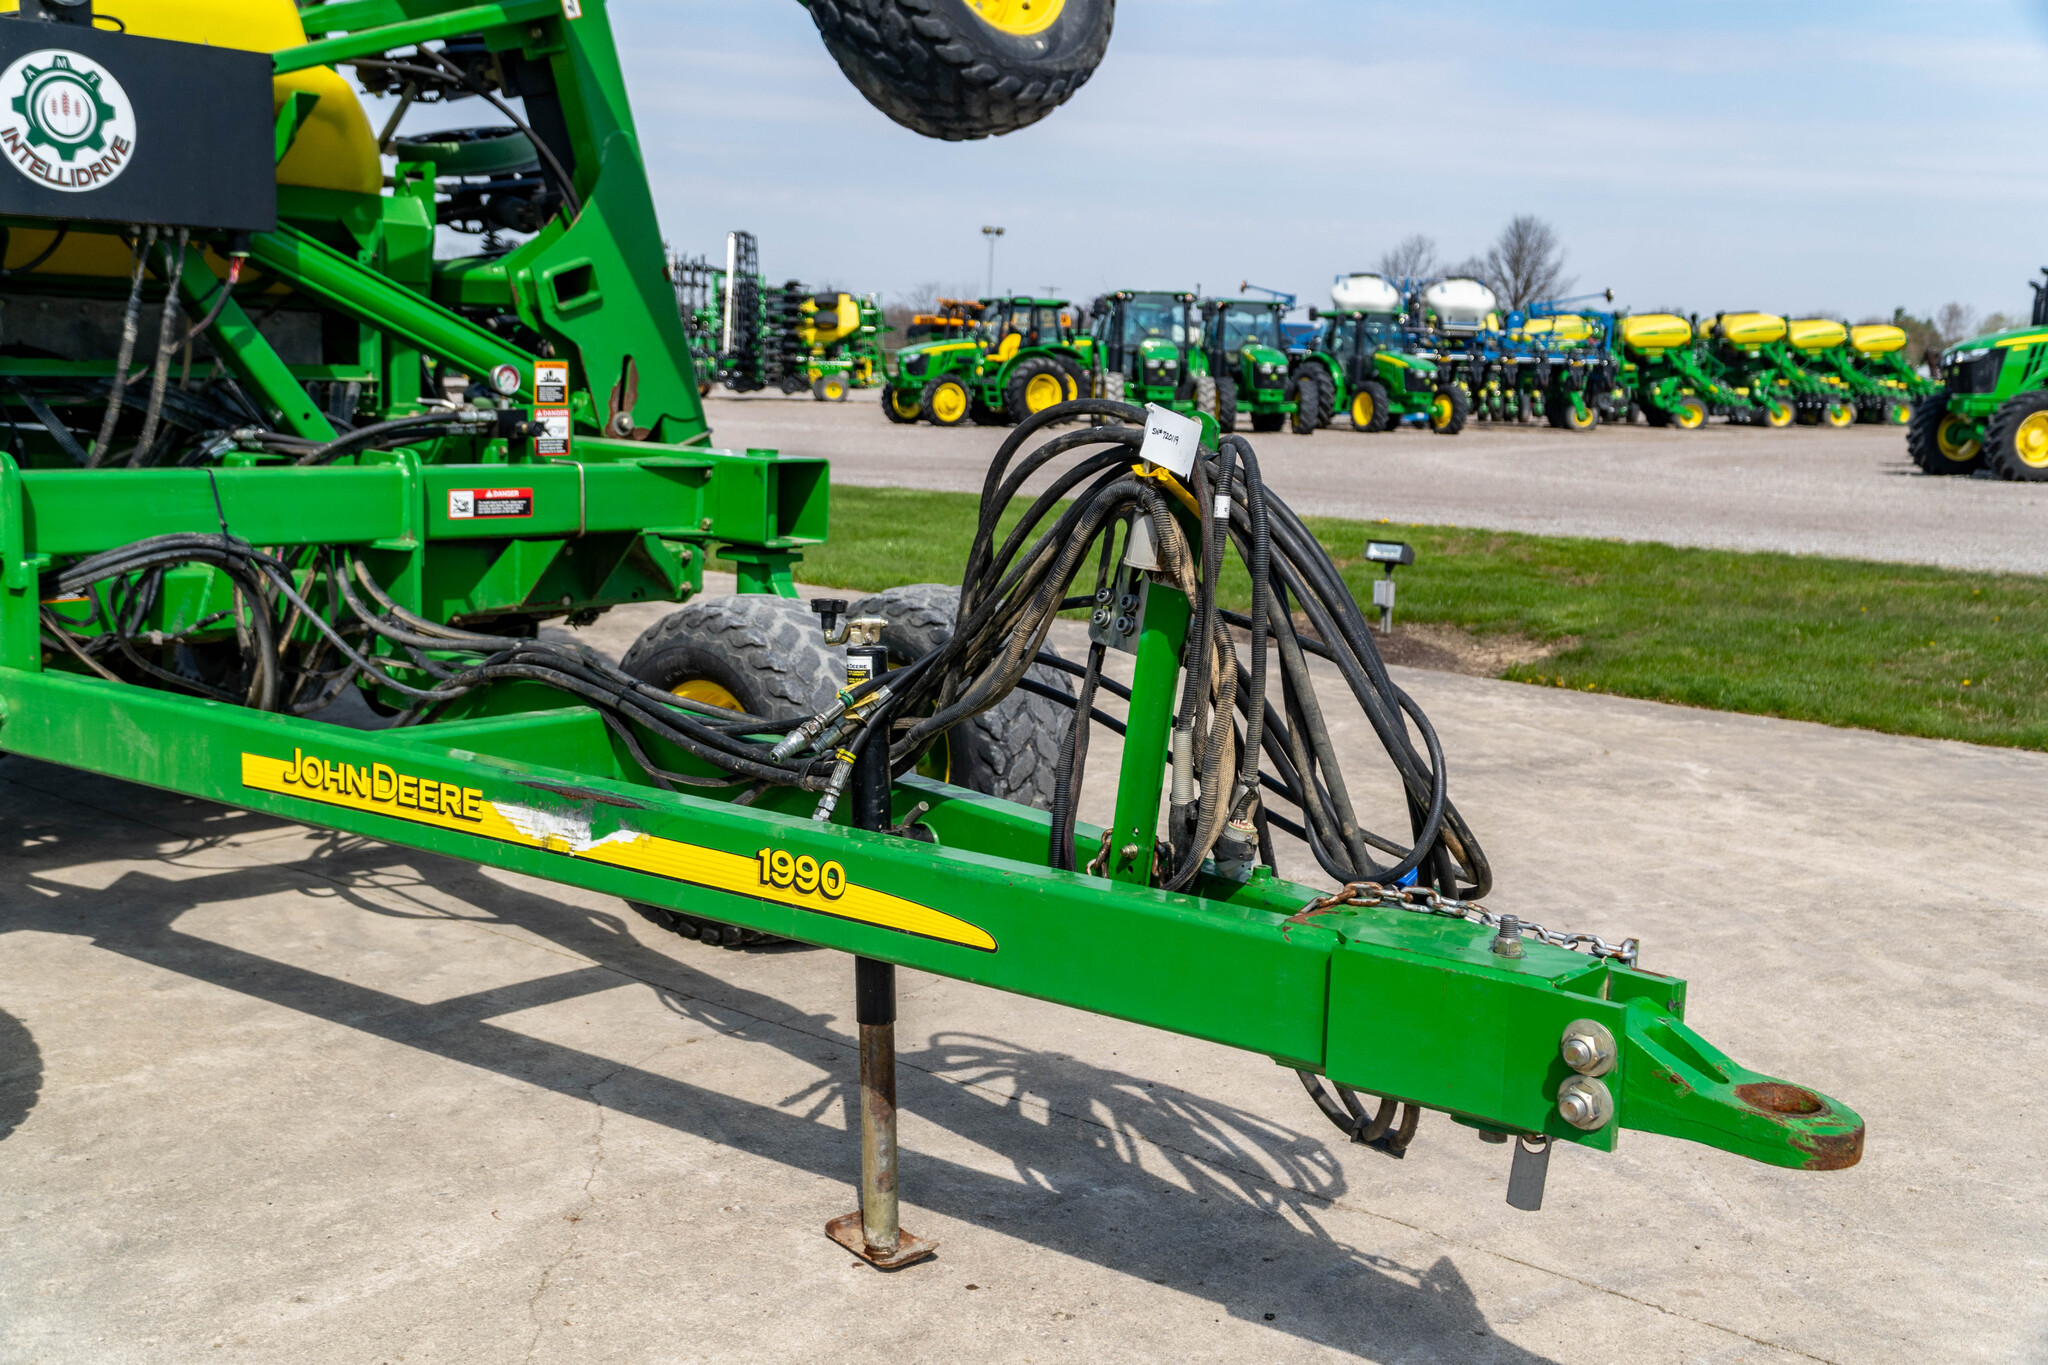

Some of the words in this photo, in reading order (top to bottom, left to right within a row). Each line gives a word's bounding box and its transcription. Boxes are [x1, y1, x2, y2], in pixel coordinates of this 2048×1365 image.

[1, 127, 131, 187] INTELLIDRIVE
[543, 409, 568, 417] DANGER
[493, 489, 519, 497] DANGER
[284, 747, 367, 799] JOHN
[372, 762, 484, 823] DEERE
[757, 846, 847, 901] 1990
